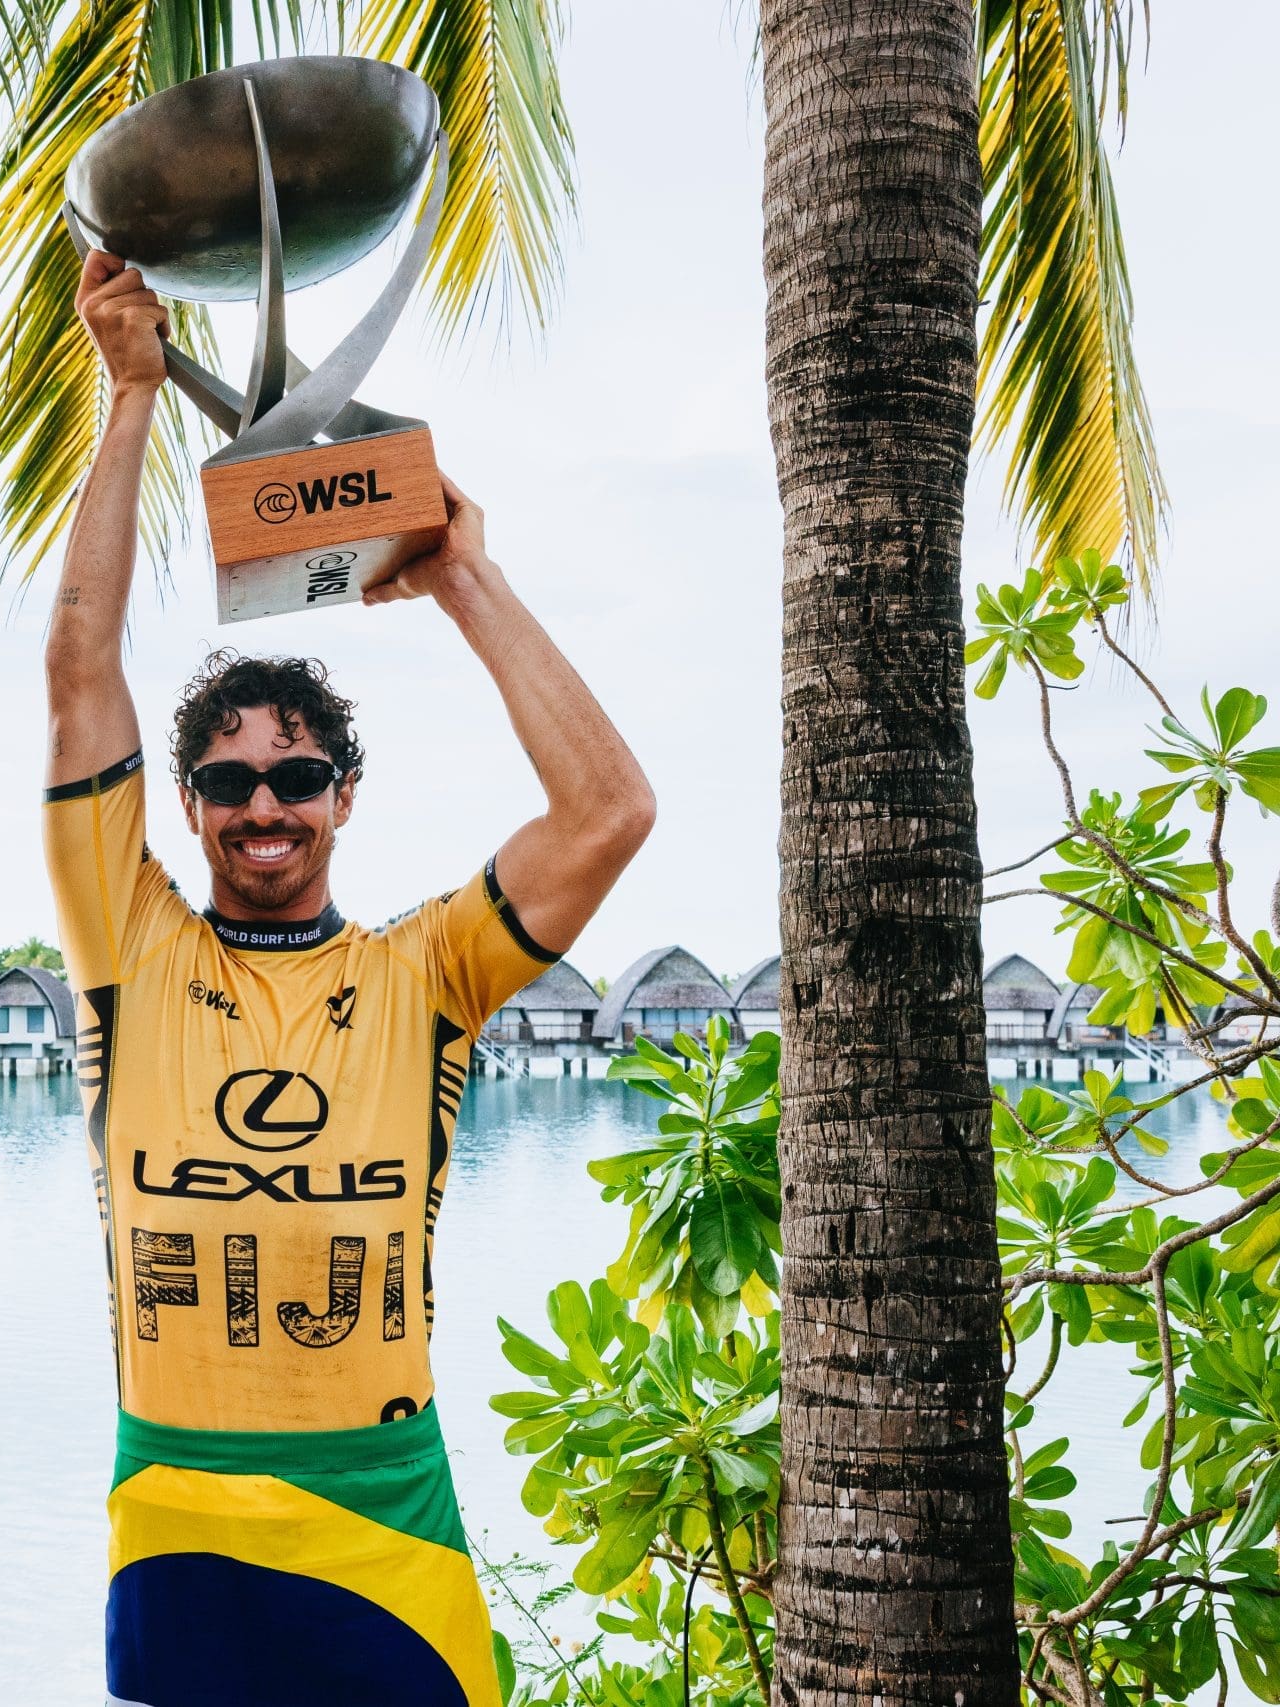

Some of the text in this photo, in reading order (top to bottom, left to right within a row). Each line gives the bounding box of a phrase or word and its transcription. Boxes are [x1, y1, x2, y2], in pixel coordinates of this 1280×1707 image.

[297, 469, 393, 514] WSL
[216, 924, 322, 944] WORLD SURF LEAGUE
[133, 1150, 406, 1202] LEXUS
[131, 1227, 406, 1349] FIJI
